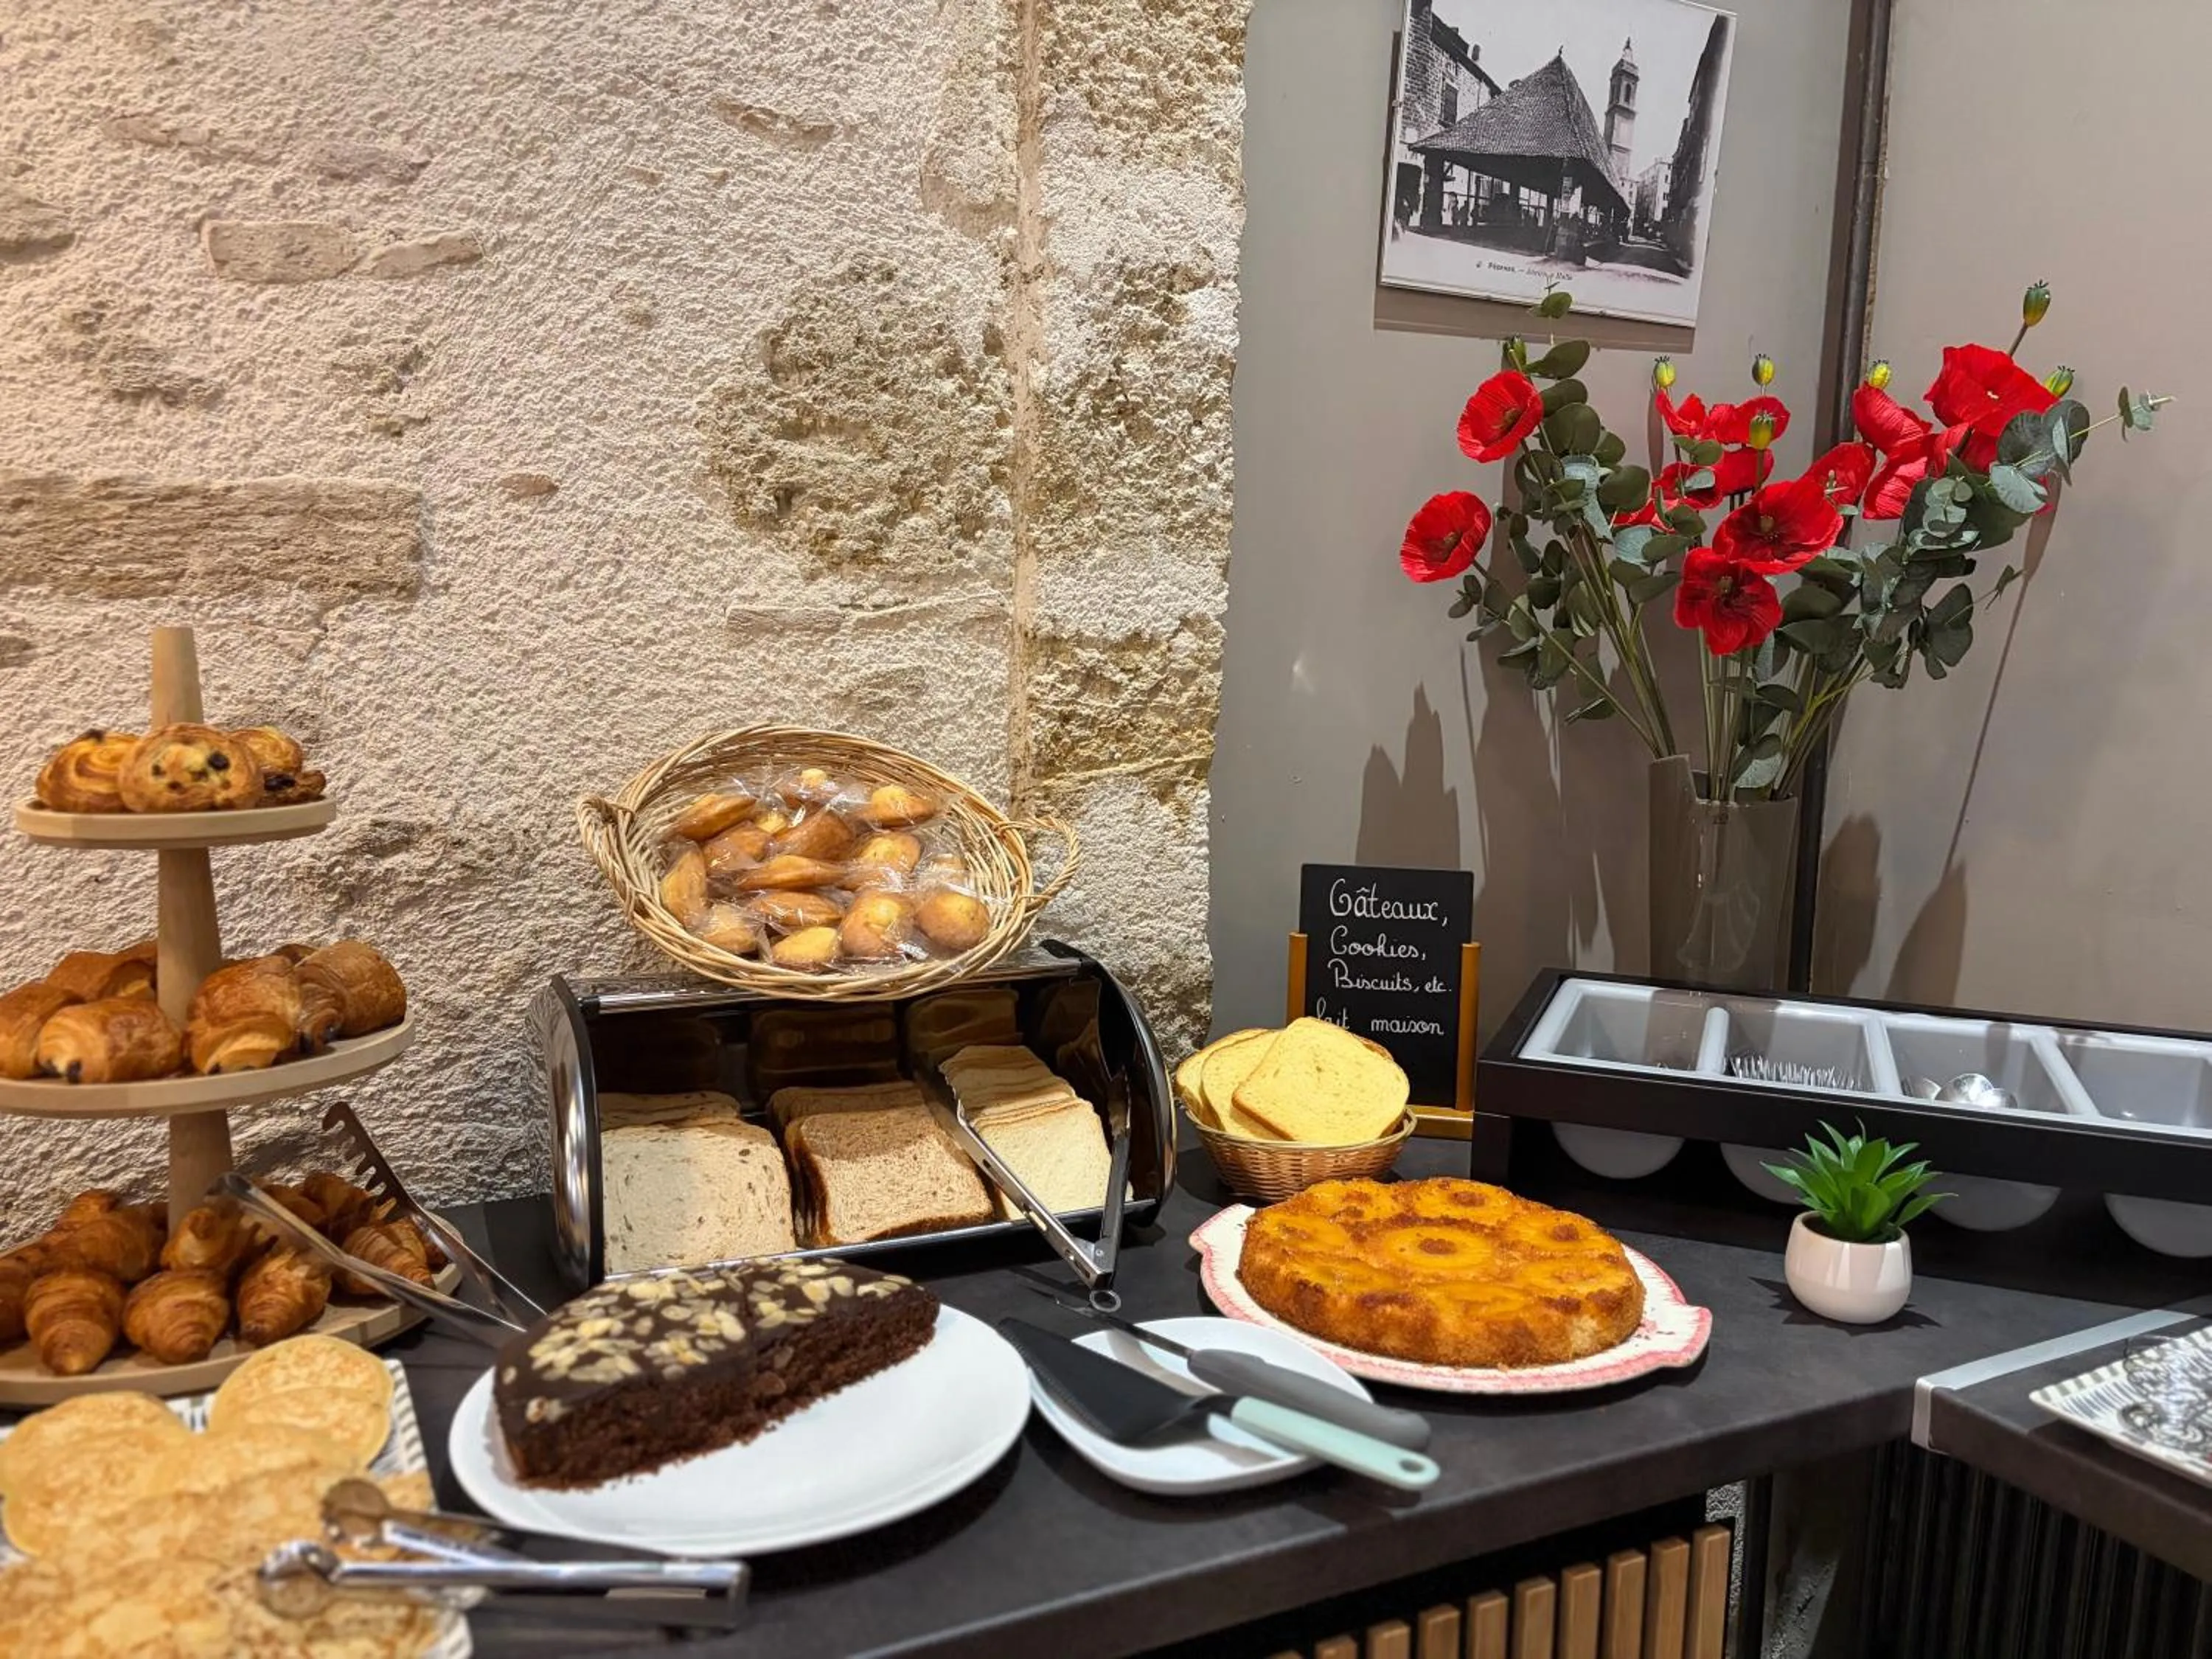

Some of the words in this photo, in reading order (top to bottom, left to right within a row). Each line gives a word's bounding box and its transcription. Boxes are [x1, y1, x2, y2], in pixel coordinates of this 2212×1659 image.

[1329, 878, 1447, 927] Gâteaux,
[1330, 925, 1426, 961] Cookies,
[1328, 958, 1419, 993] Biscuits,
[1425, 975, 1453, 993] etc.
[1371, 1015, 1444, 1035] maison
